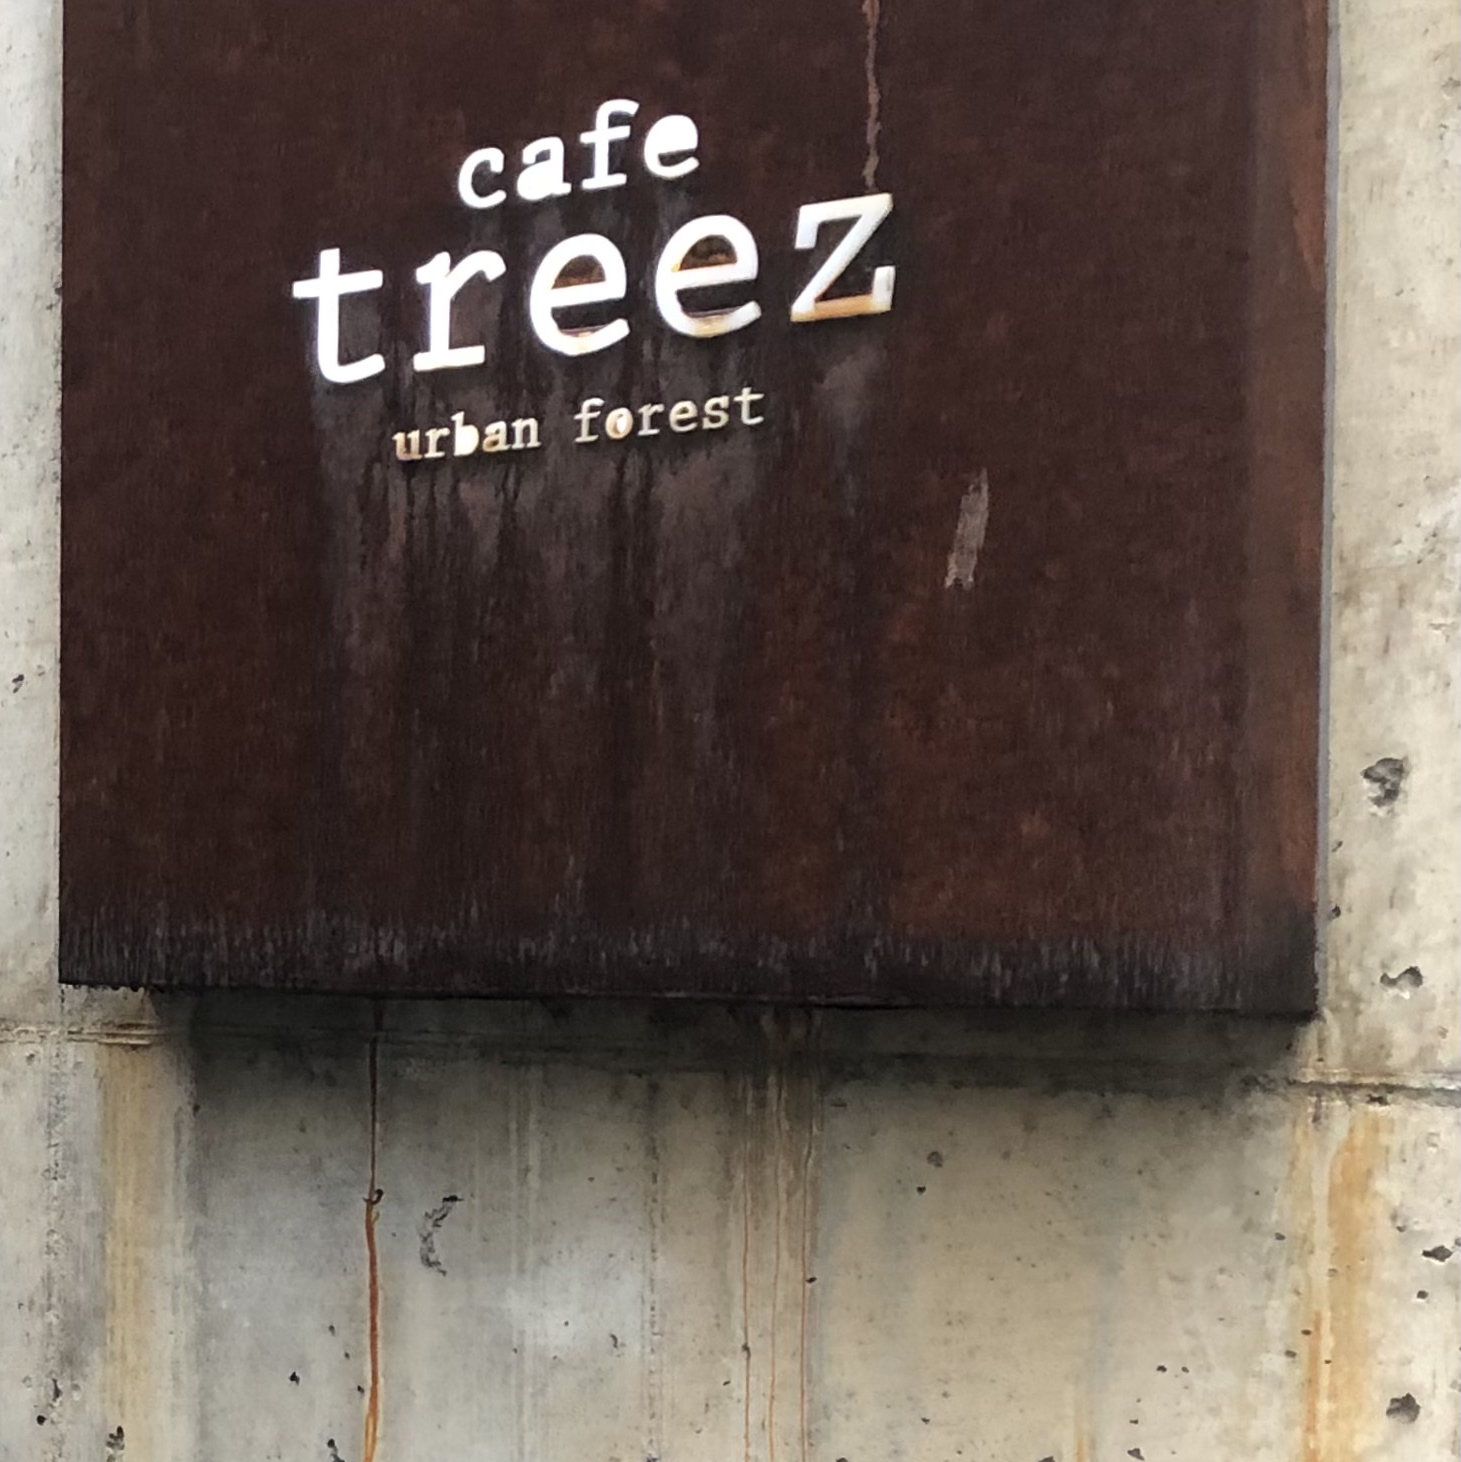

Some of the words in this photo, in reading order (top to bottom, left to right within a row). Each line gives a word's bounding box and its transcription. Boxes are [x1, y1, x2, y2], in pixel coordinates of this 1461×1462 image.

[458, 98, 699, 208] cafe
[292, 193, 895, 384] treez
[393, 410, 541, 462] urban
[574, 387, 765, 443] forest
